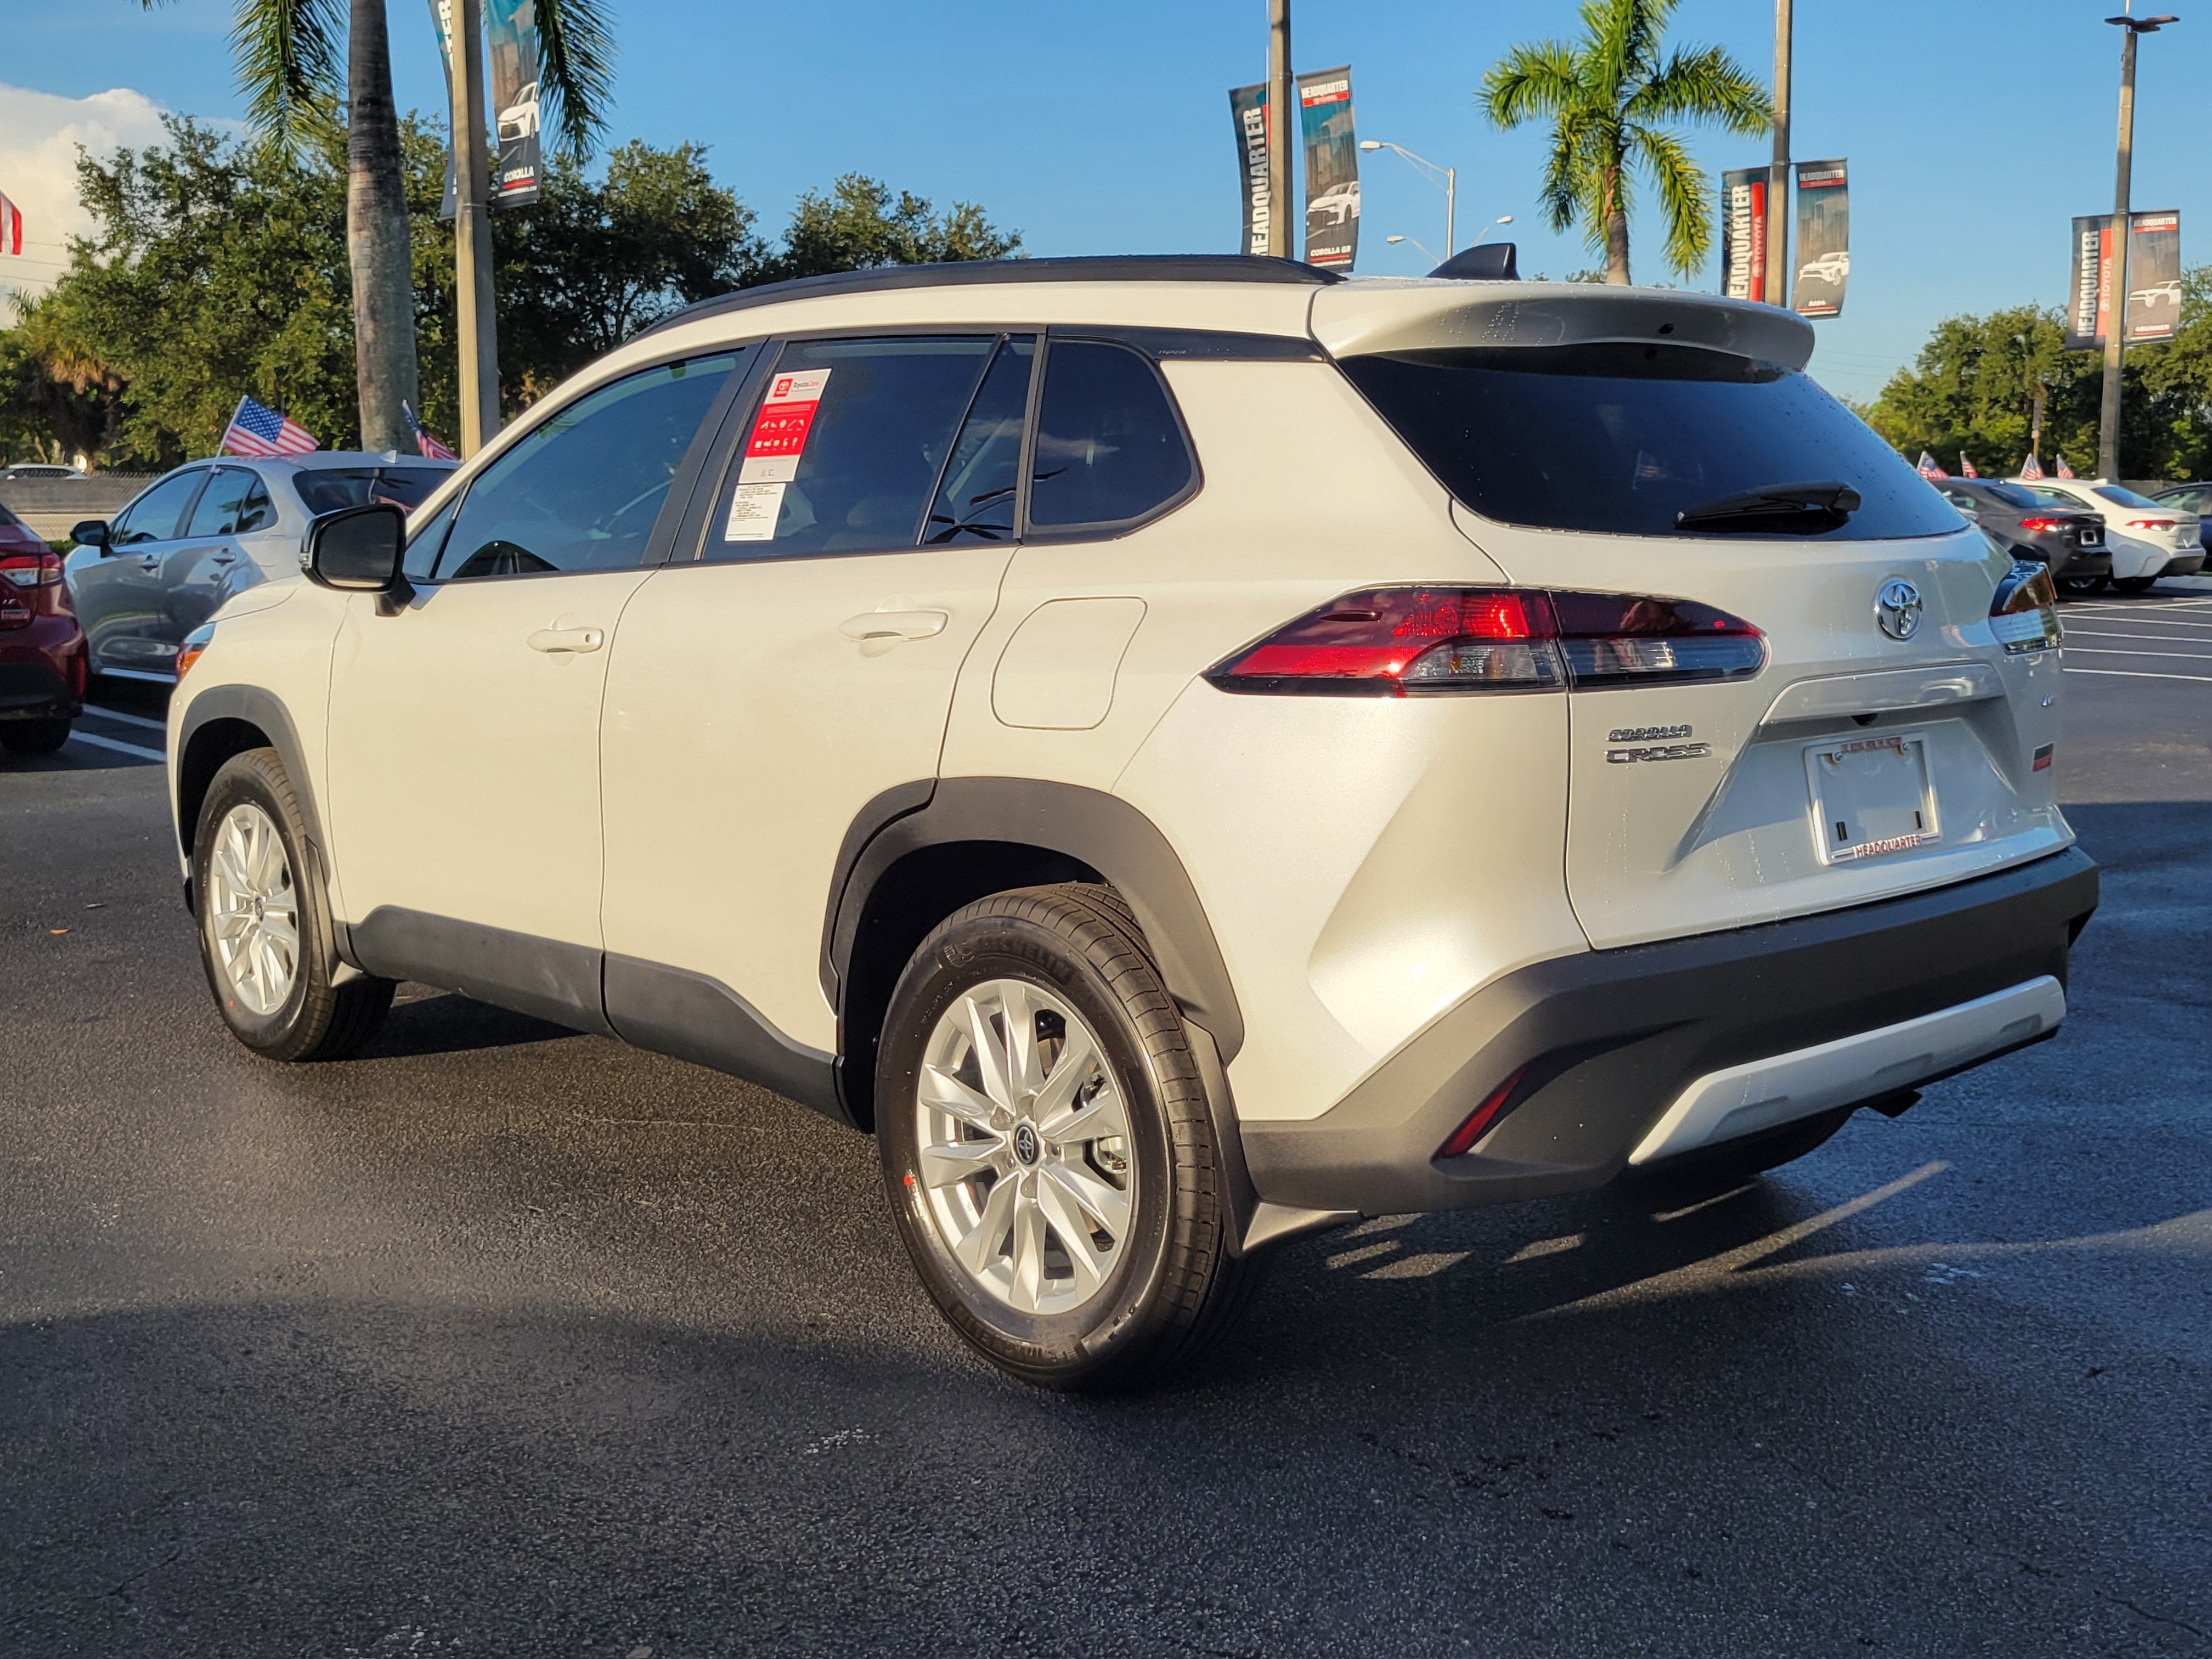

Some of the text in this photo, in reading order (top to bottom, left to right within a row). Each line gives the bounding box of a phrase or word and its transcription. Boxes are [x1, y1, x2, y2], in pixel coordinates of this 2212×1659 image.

[2076, 230, 2100, 337] HEADQUARTER
[1608, 724, 1692, 742] COROLLA
[1606, 742, 1712, 764] CROSS
[1852, 834, 1922, 859] HEADQUARTER
